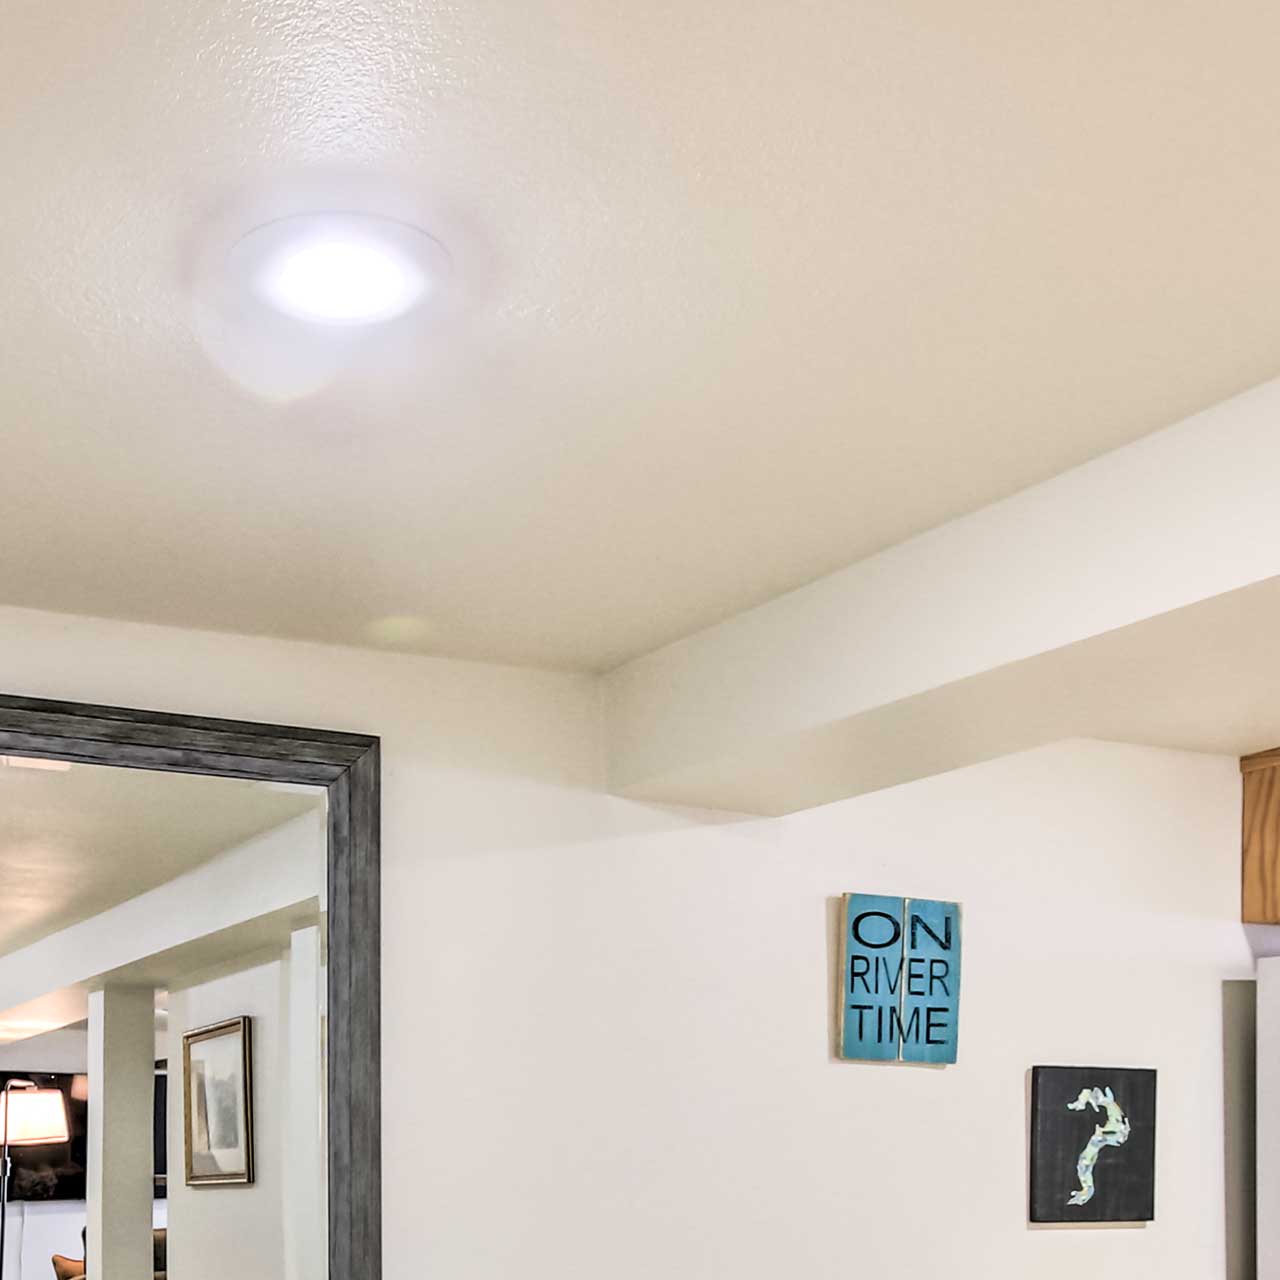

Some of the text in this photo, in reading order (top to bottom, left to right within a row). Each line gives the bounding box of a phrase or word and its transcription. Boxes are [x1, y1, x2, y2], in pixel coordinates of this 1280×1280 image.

[852, 911, 952, 951] ON
[850, 955, 950, 996] RIVER
[850, 1005, 949, 1044] TIME
